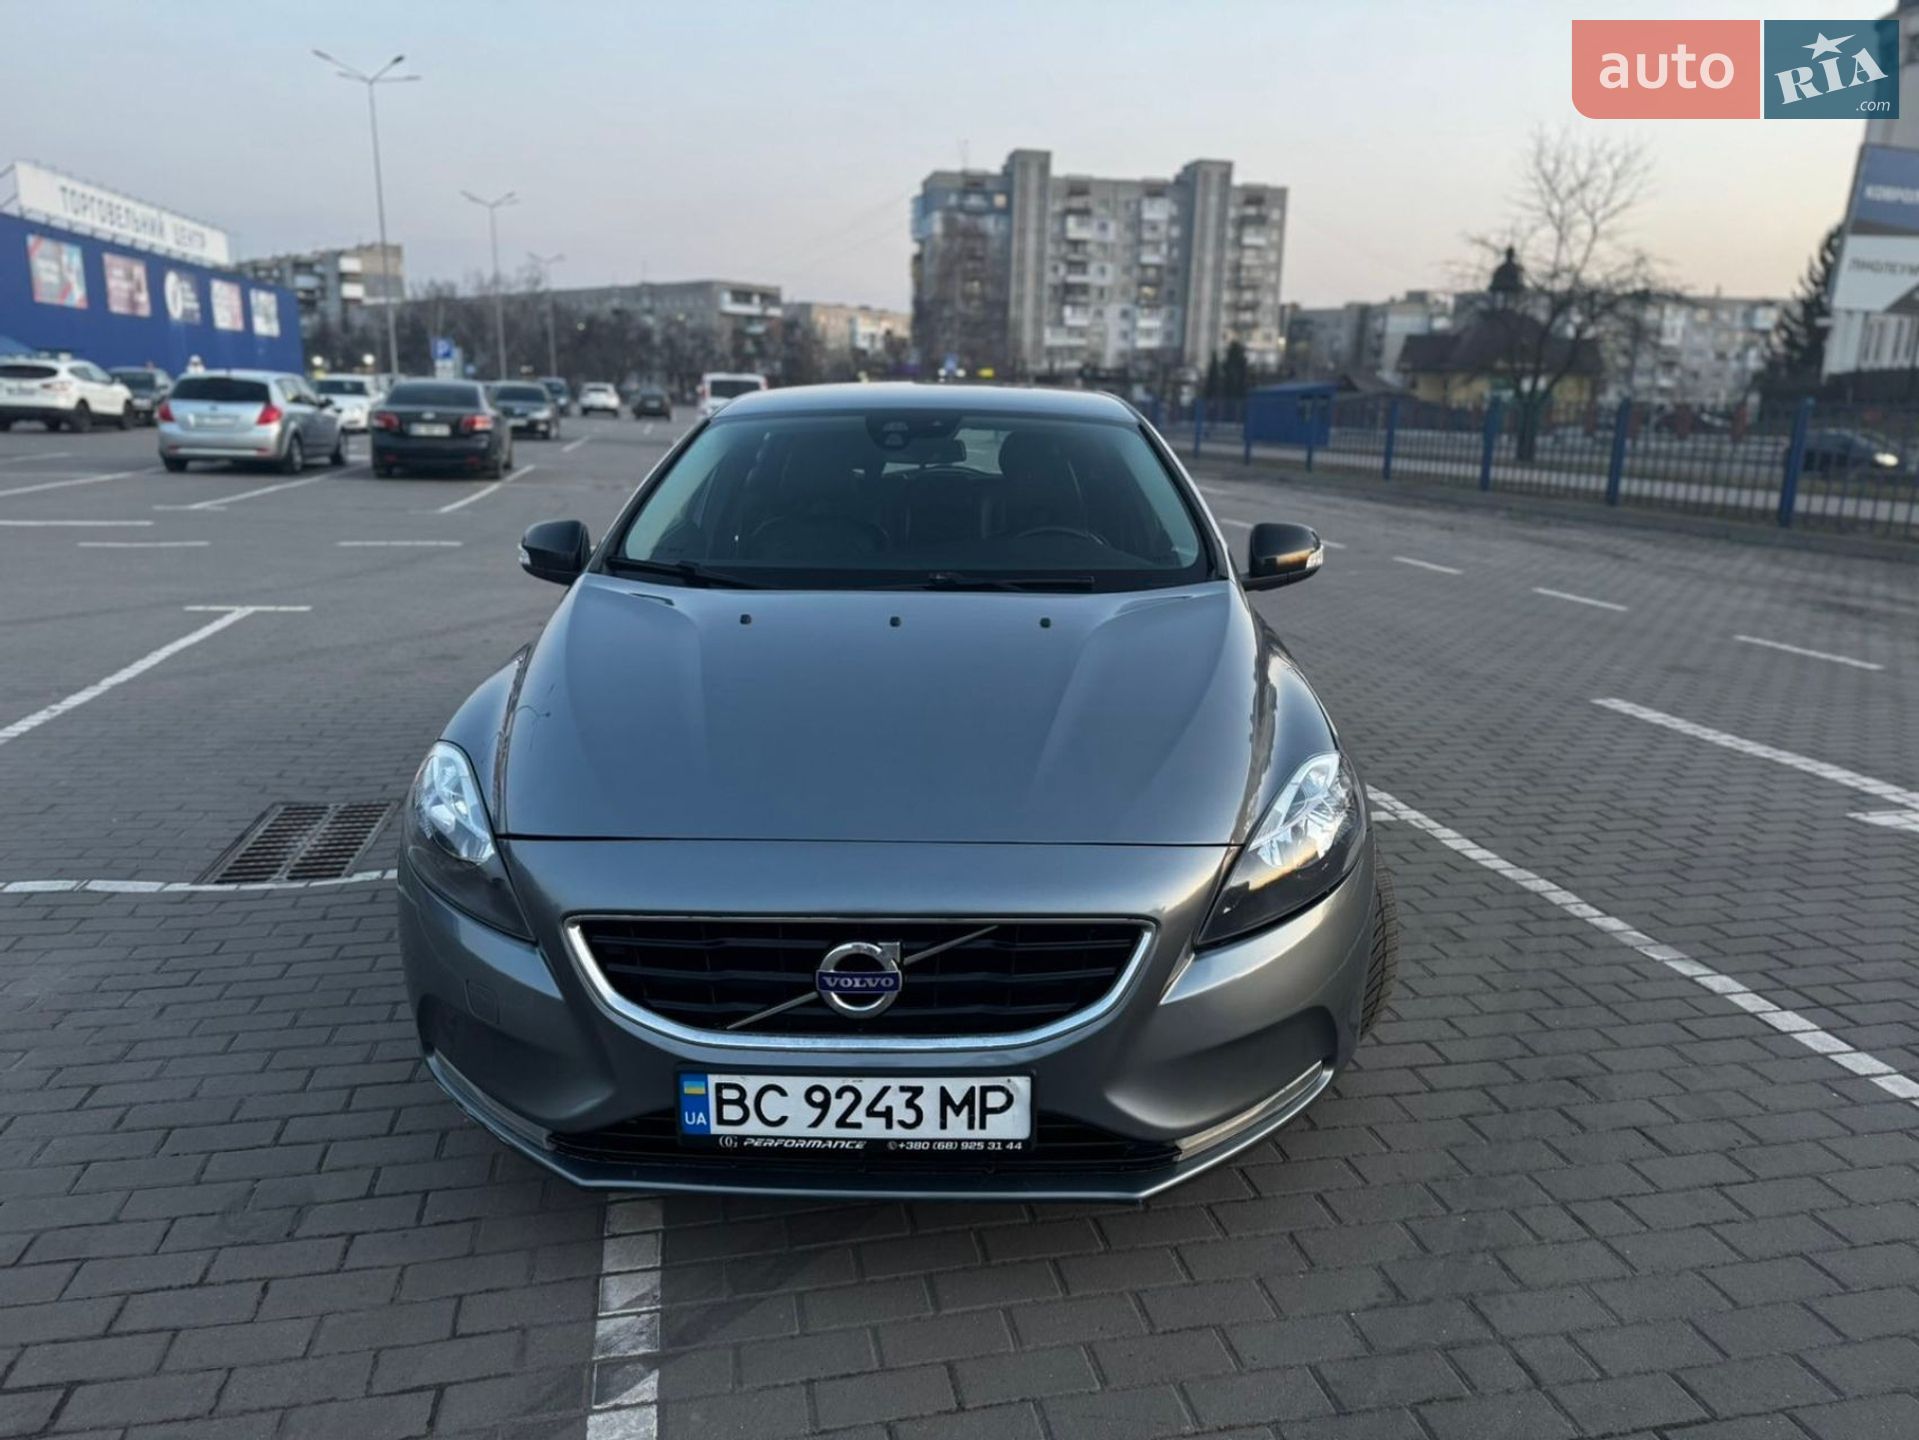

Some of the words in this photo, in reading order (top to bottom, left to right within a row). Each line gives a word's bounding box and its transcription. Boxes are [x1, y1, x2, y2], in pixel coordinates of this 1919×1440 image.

[821, 976, 895, 988] VOLVO
[714, 1082, 789, 1128] BC
[804, 1083, 925, 1131] 9243
[939, 1085, 1015, 1131] MP
[684, 1111, 708, 1126] UA
[743, 1137, 867, 1150] PERFORMANCE
[898, 1141, 930, 1151] +380
[932, 1141, 958, 1151] (68)
[961, 1141, 985, 1151] 925
[987, 1141, 1003, 1151] 31
[1006, 1141, 1023, 1151] 44
